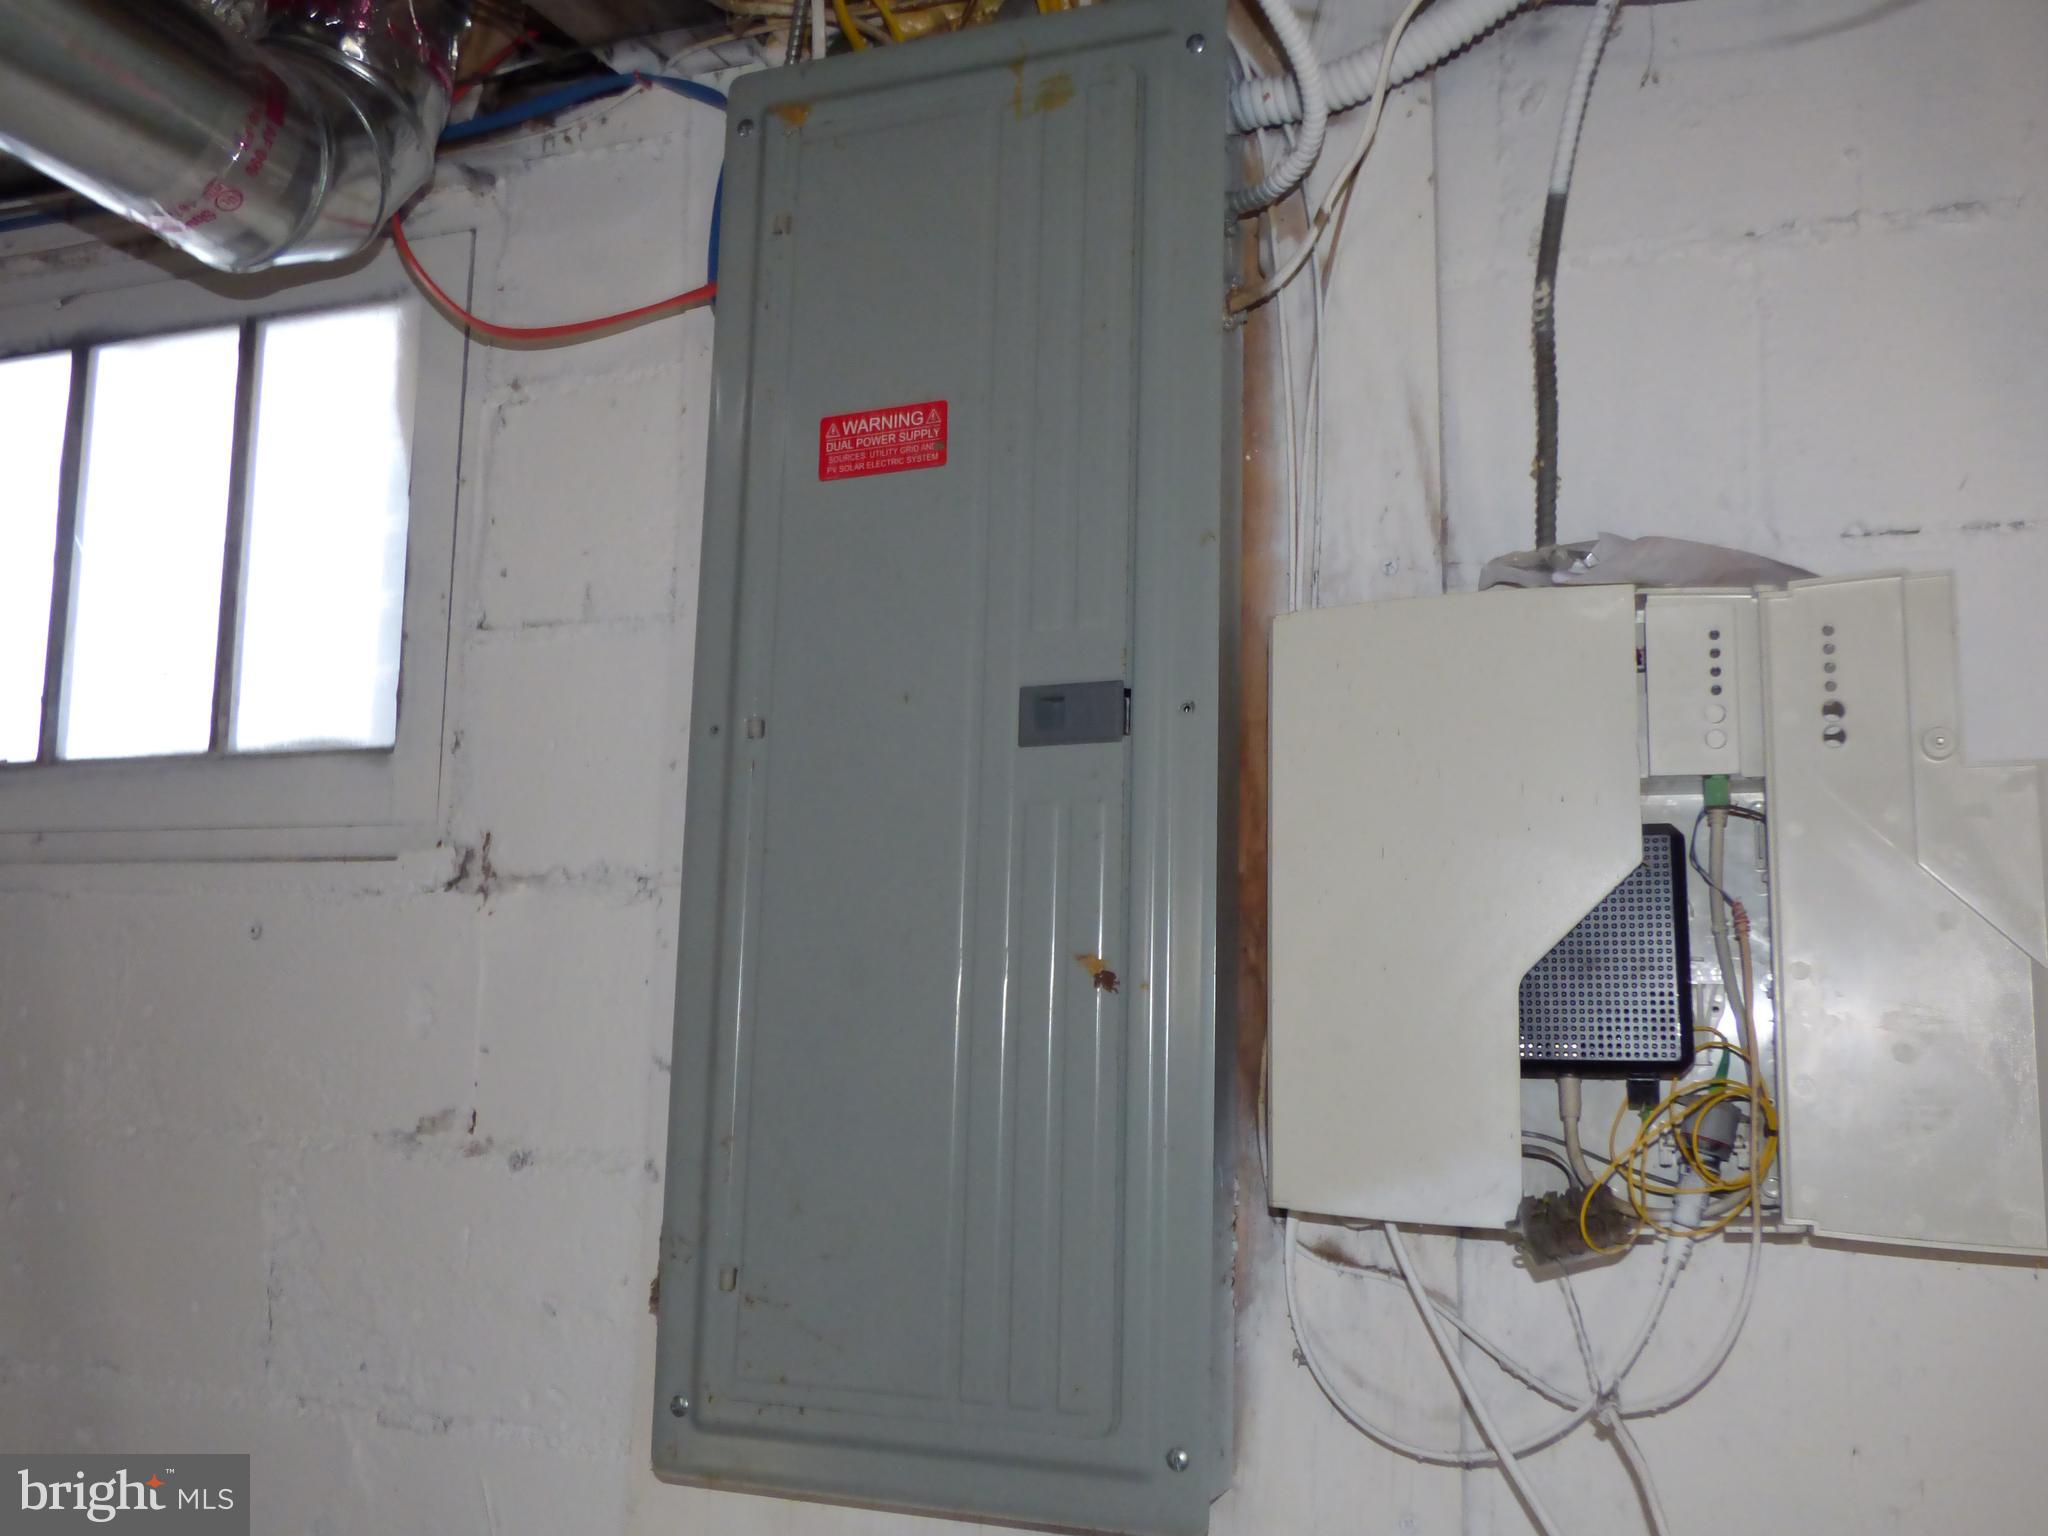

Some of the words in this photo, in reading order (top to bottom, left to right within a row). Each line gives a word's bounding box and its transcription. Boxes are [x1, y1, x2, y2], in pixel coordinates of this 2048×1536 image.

[842, 411, 924, 435] WARNING
[826, 440, 853, 452] DUAL
[856, 434, 896, 447] POWER
[899, 428, 940, 442] SUPPLY
[869, 448, 898, 459] UTILITY
[900, 444, 919, 455] GRID
[826, 466, 837, 474] PV
[839, 463, 865, 473] SOLAR
[866, 458, 904, 469] ELECTRIC
[906, 452, 939, 463] SYSTEM
